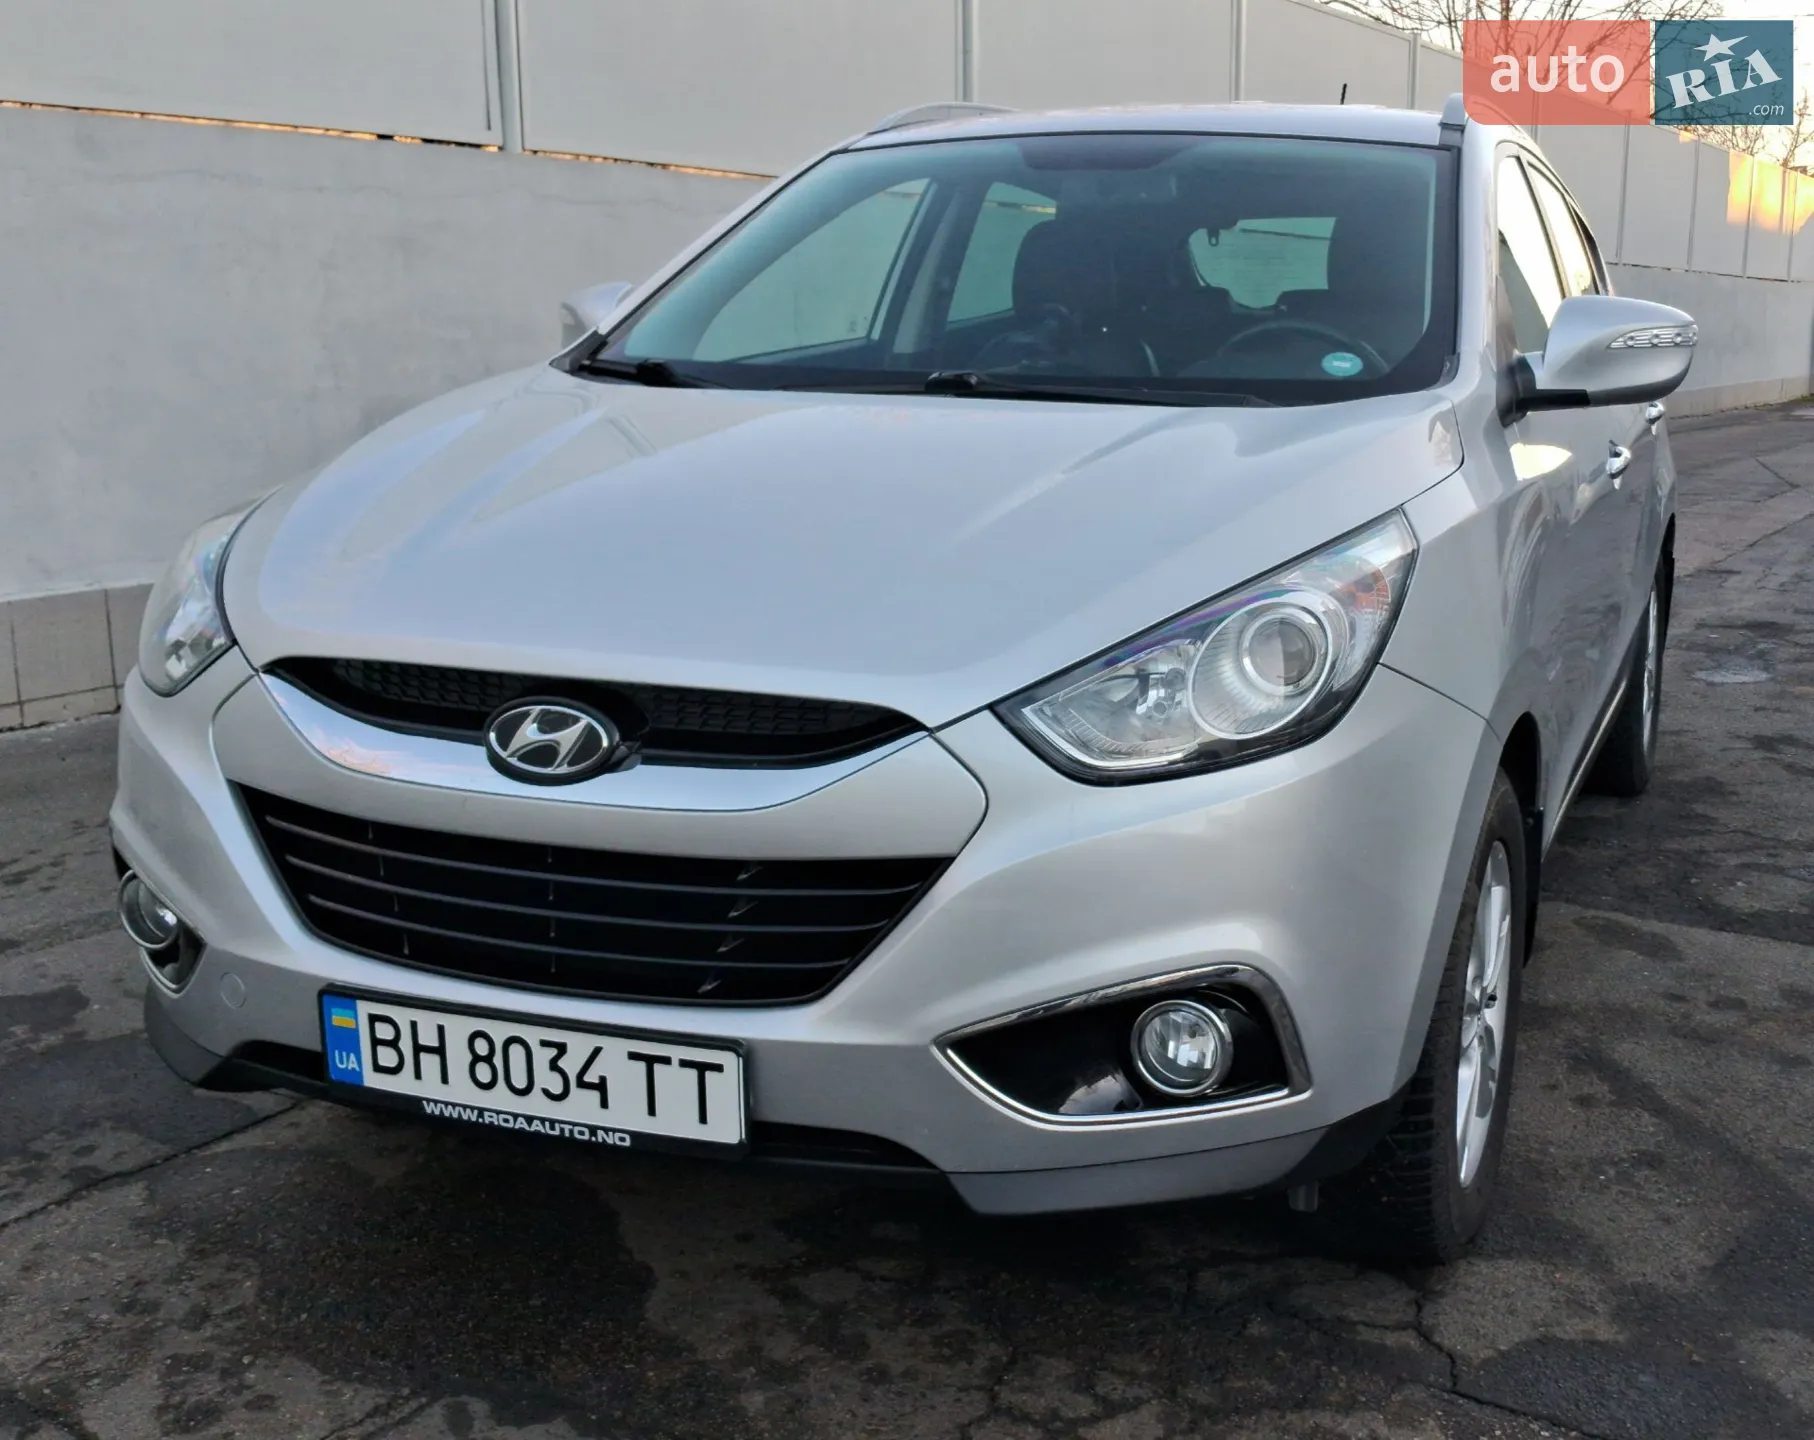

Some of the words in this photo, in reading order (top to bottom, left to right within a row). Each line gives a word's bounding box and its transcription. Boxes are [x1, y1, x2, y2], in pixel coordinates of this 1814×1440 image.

[334, 1050, 360, 1072] UA
[368, 1013, 449, 1085] BH
[467, 1029, 609, 1110] 8034
[627, 1050, 724, 1125] TT
[423, 1100, 631, 1147] WWW.ROAAUTO.NO
